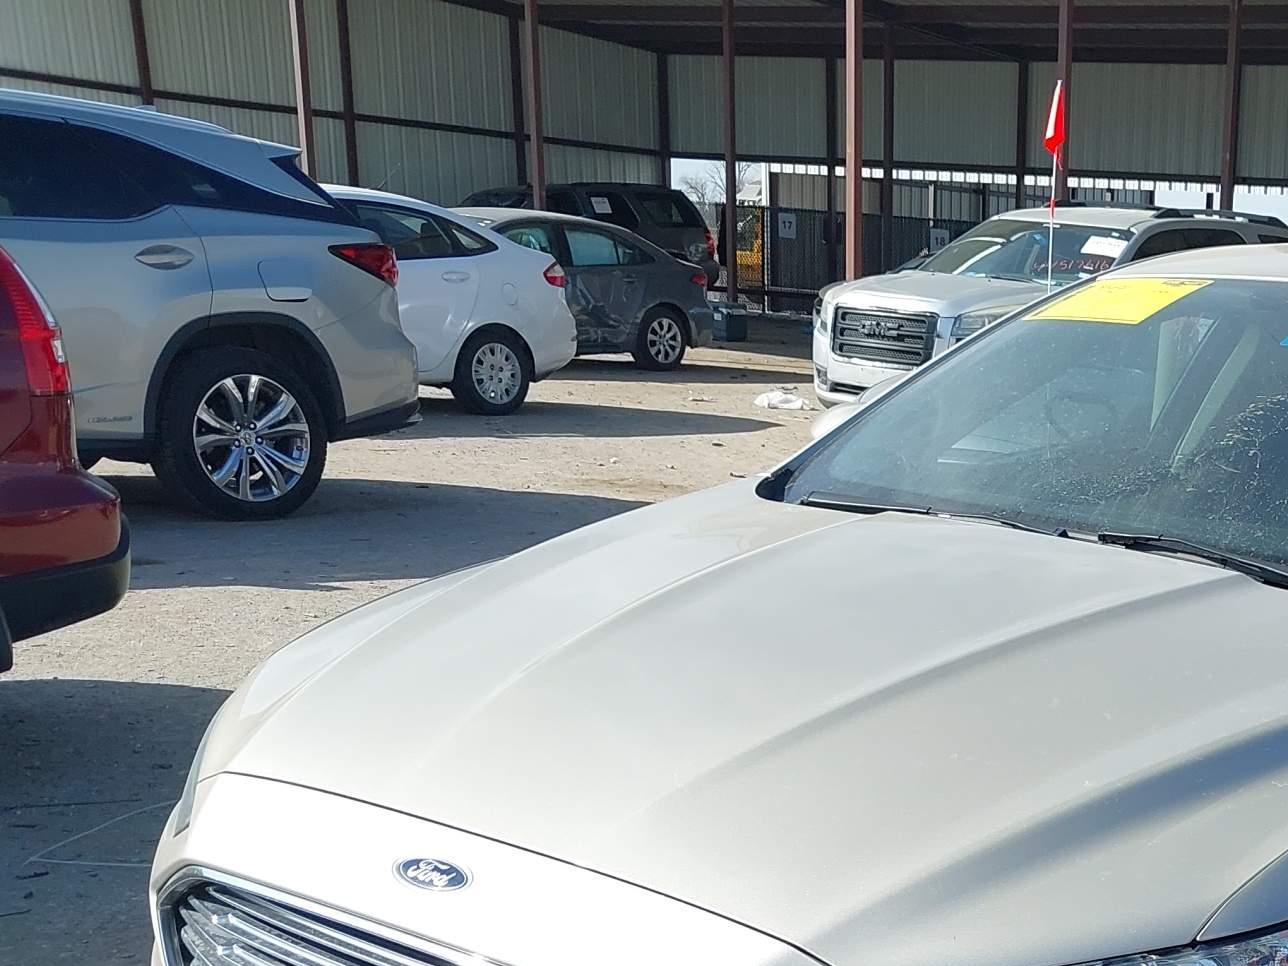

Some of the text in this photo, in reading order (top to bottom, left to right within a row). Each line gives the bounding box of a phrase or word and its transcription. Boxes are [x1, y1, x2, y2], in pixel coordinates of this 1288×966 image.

[782, 220, 793, 231] 17
[934, 236, 946, 247] 18
[860, 319, 900, 337] GMC
[406, 859, 457, 888] Ford
